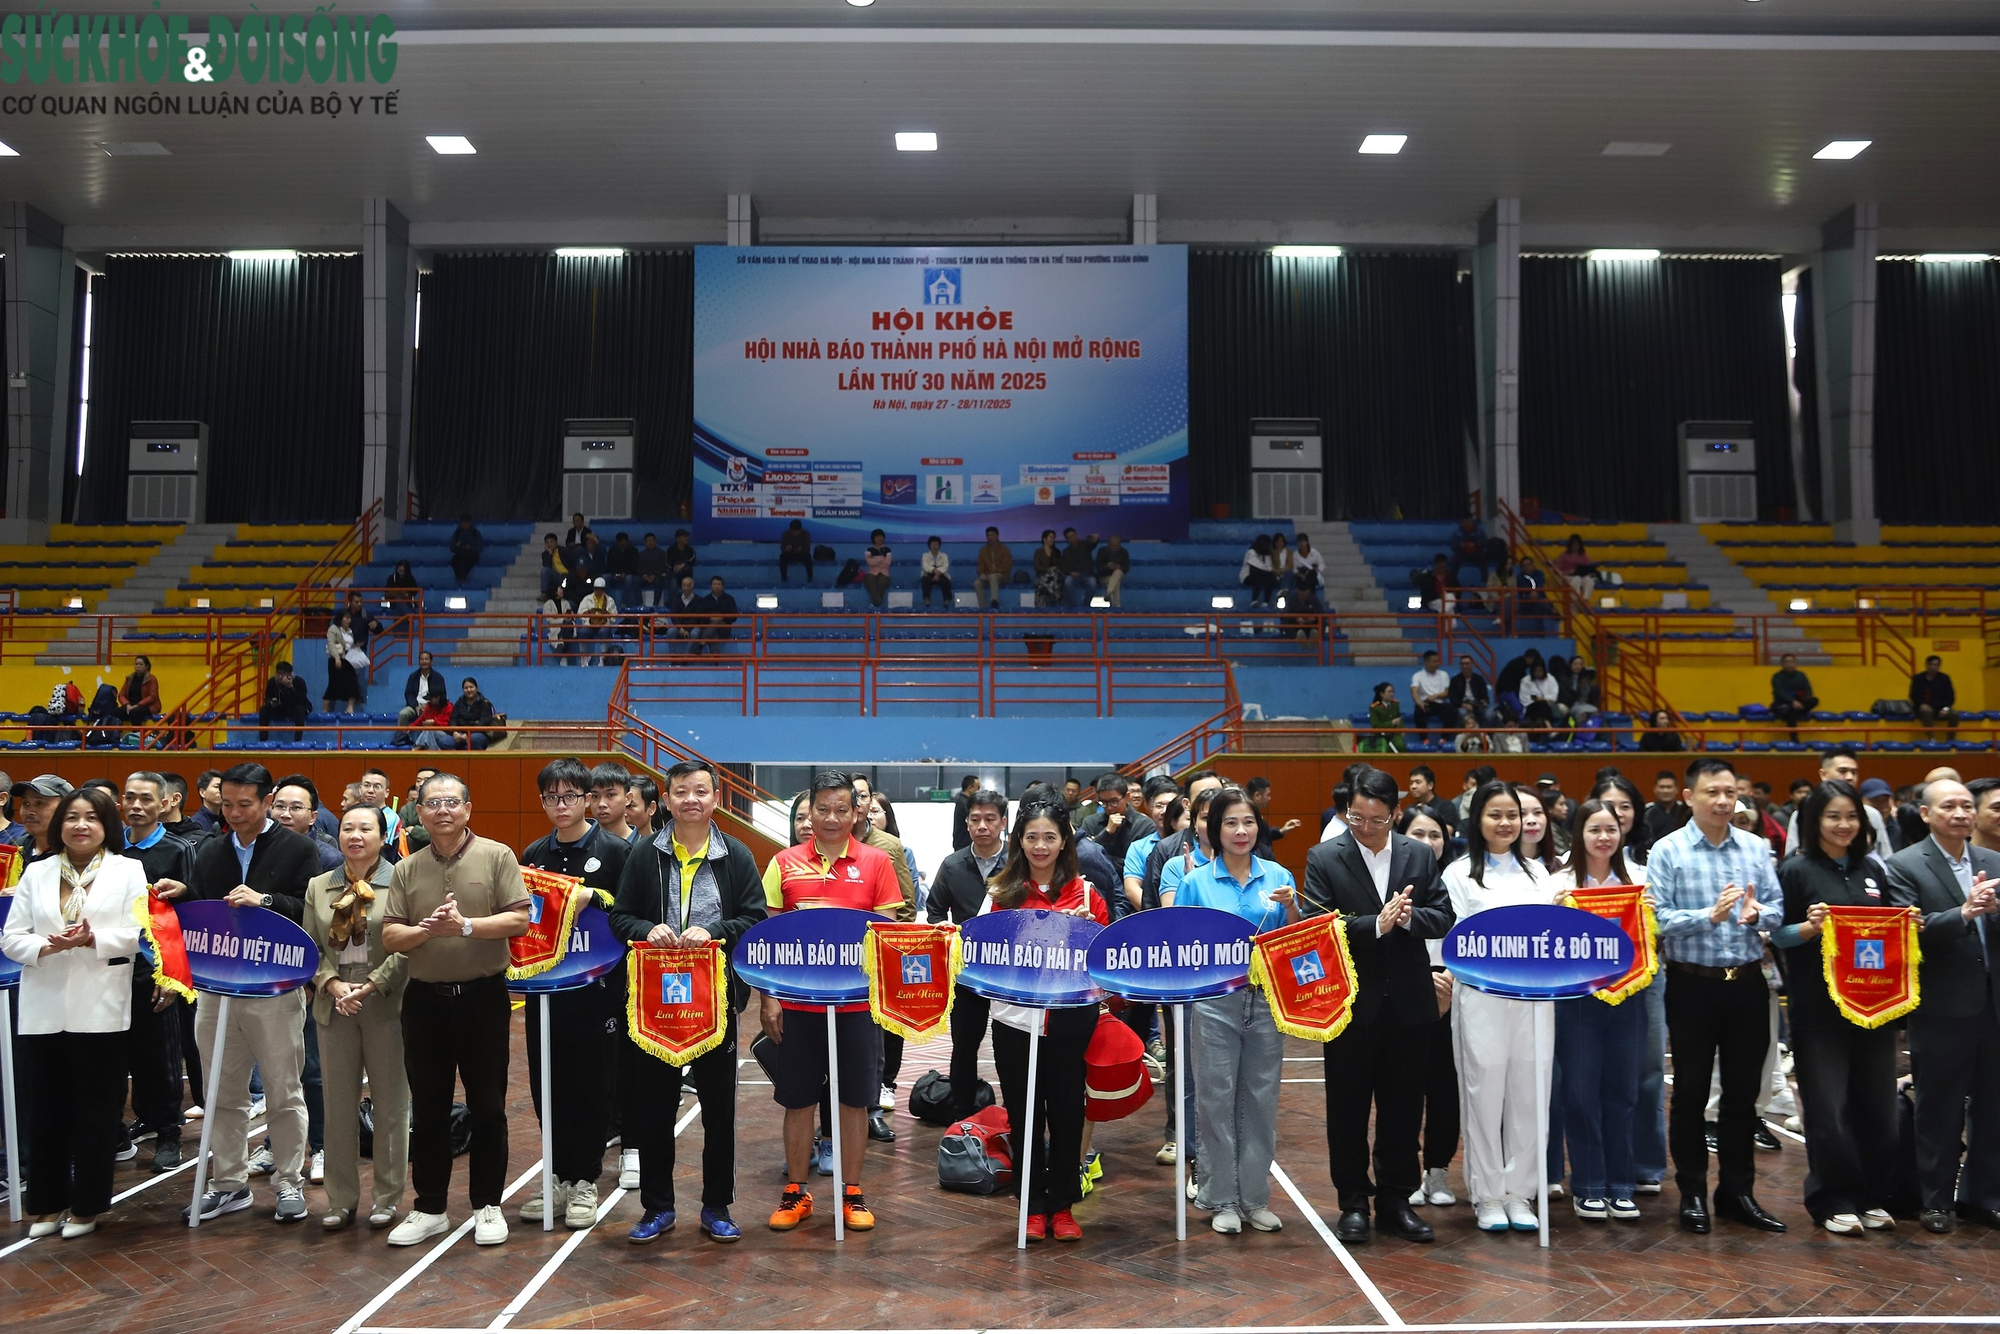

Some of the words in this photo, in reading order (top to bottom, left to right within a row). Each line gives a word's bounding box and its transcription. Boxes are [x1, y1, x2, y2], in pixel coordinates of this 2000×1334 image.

[872, 307, 924, 336] HỘI
[935, 306, 1012, 331] KHỎE
[744, 338, 776, 363] HỘI
[782, 338, 821, 360] NHÀ
[827, 338, 865, 360] BÁO
[871, 338, 932, 360] THÀNH
[939, 336, 976, 360] PHỐ
[983, 338, 1008, 360] HÀ
[1014, 337, 1046, 362] NỘI
[1053, 335, 1083, 360] MỞ
[1089, 337, 1140, 363] RỘNG
[838, 366, 875, 391] LẦN
[881, 368, 918, 391] THỨ
[922, 372, 944, 391] 30
[951, 368, 994, 391] NĂM
[1001, 372, 1046, 391] 2025
[873, 399, 884, 410] Hà
[911, 400, 933, 413] ngày
[936, 400, 948, 410] 27
[958, 400, 1011, 410] 28/11/2025
[183, 927, 208, 953] NHÀ
[211, 931, 239, 958] BÁO
[243, 935, 271, 966] VIỆT
[272, 942, 305, 968] NAM
[564, 926, 590, 953] ÀI
[747, 938, 770, 969] HỘI
[775, 938, 803, 965] NHÀ
[807, 938, 835, 966] BÁO
[962, 936, 978, 968] ỘI
[980, 939, 1010, 966] NHÀ
[1013, 940, 1042, 969] BÁO
[1046, 940, 1071, 971] HẢI
[1105, 942, 1142, 970] BÁO
[1147, 940, 1172, 968] HÀ
[1177, 939, 1209, 971] NỘI
[1214, 938, 1249, 966] MỚI
[1456, 930, 1487, 958] BÁO
[1491, 935, 1528, 958] KINH
[1531, 929, 1551, 959] TẾ
[1554, 936, 1566, 959] &
[1568, 932, 1591, 960] ĐÔ
[1594, 937, 1620, 965] THỊ
